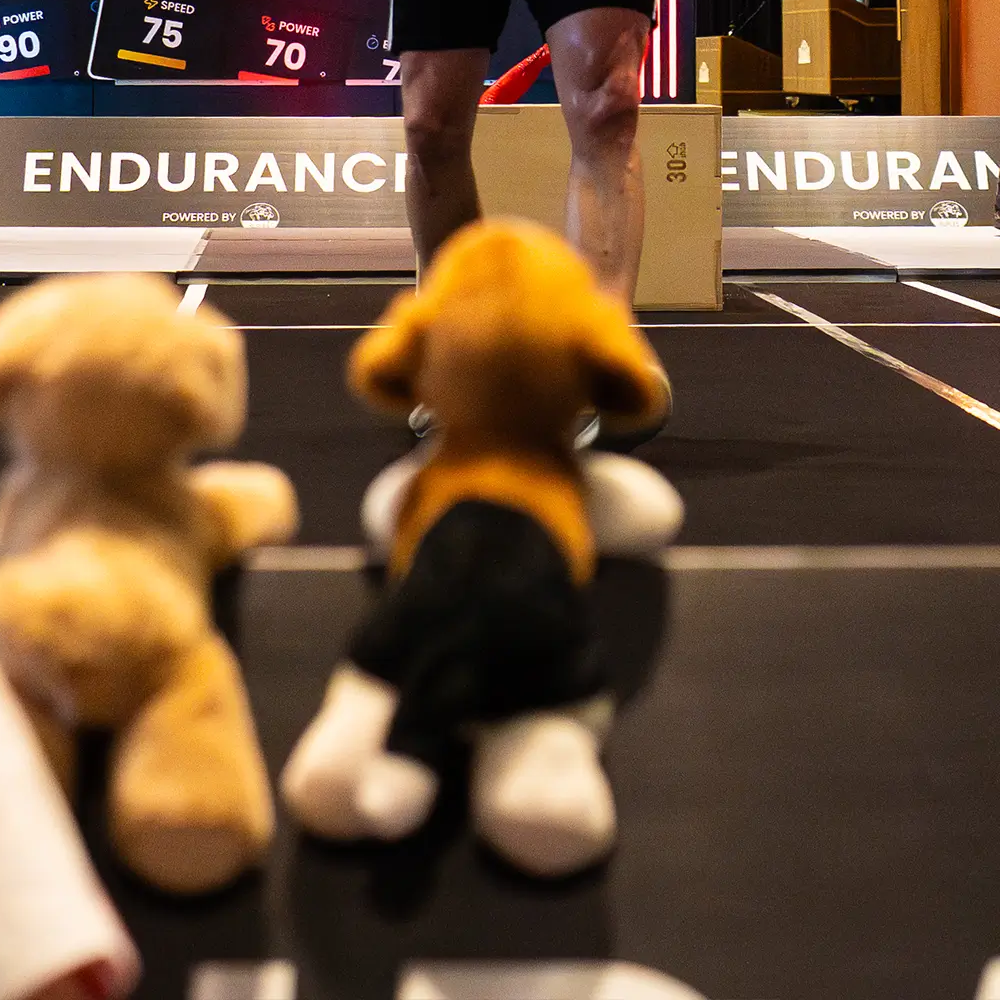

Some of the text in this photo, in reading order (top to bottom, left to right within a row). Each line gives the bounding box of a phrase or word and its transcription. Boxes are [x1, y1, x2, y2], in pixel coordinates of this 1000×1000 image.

[161, 1, 195, 15] SPEED
[3, 10, 44, 25] POWER
[142, 16, 183, 48] 75
[278, 21, 320, 37] POWER
[265, 38, 307, 71] 70
[382, 59, 400, 81] 7
[666, 160, 686, 182] 30
[163, 212, 237, 223] POWERED BY
[853, 210, 926, 220] POWERED BY
